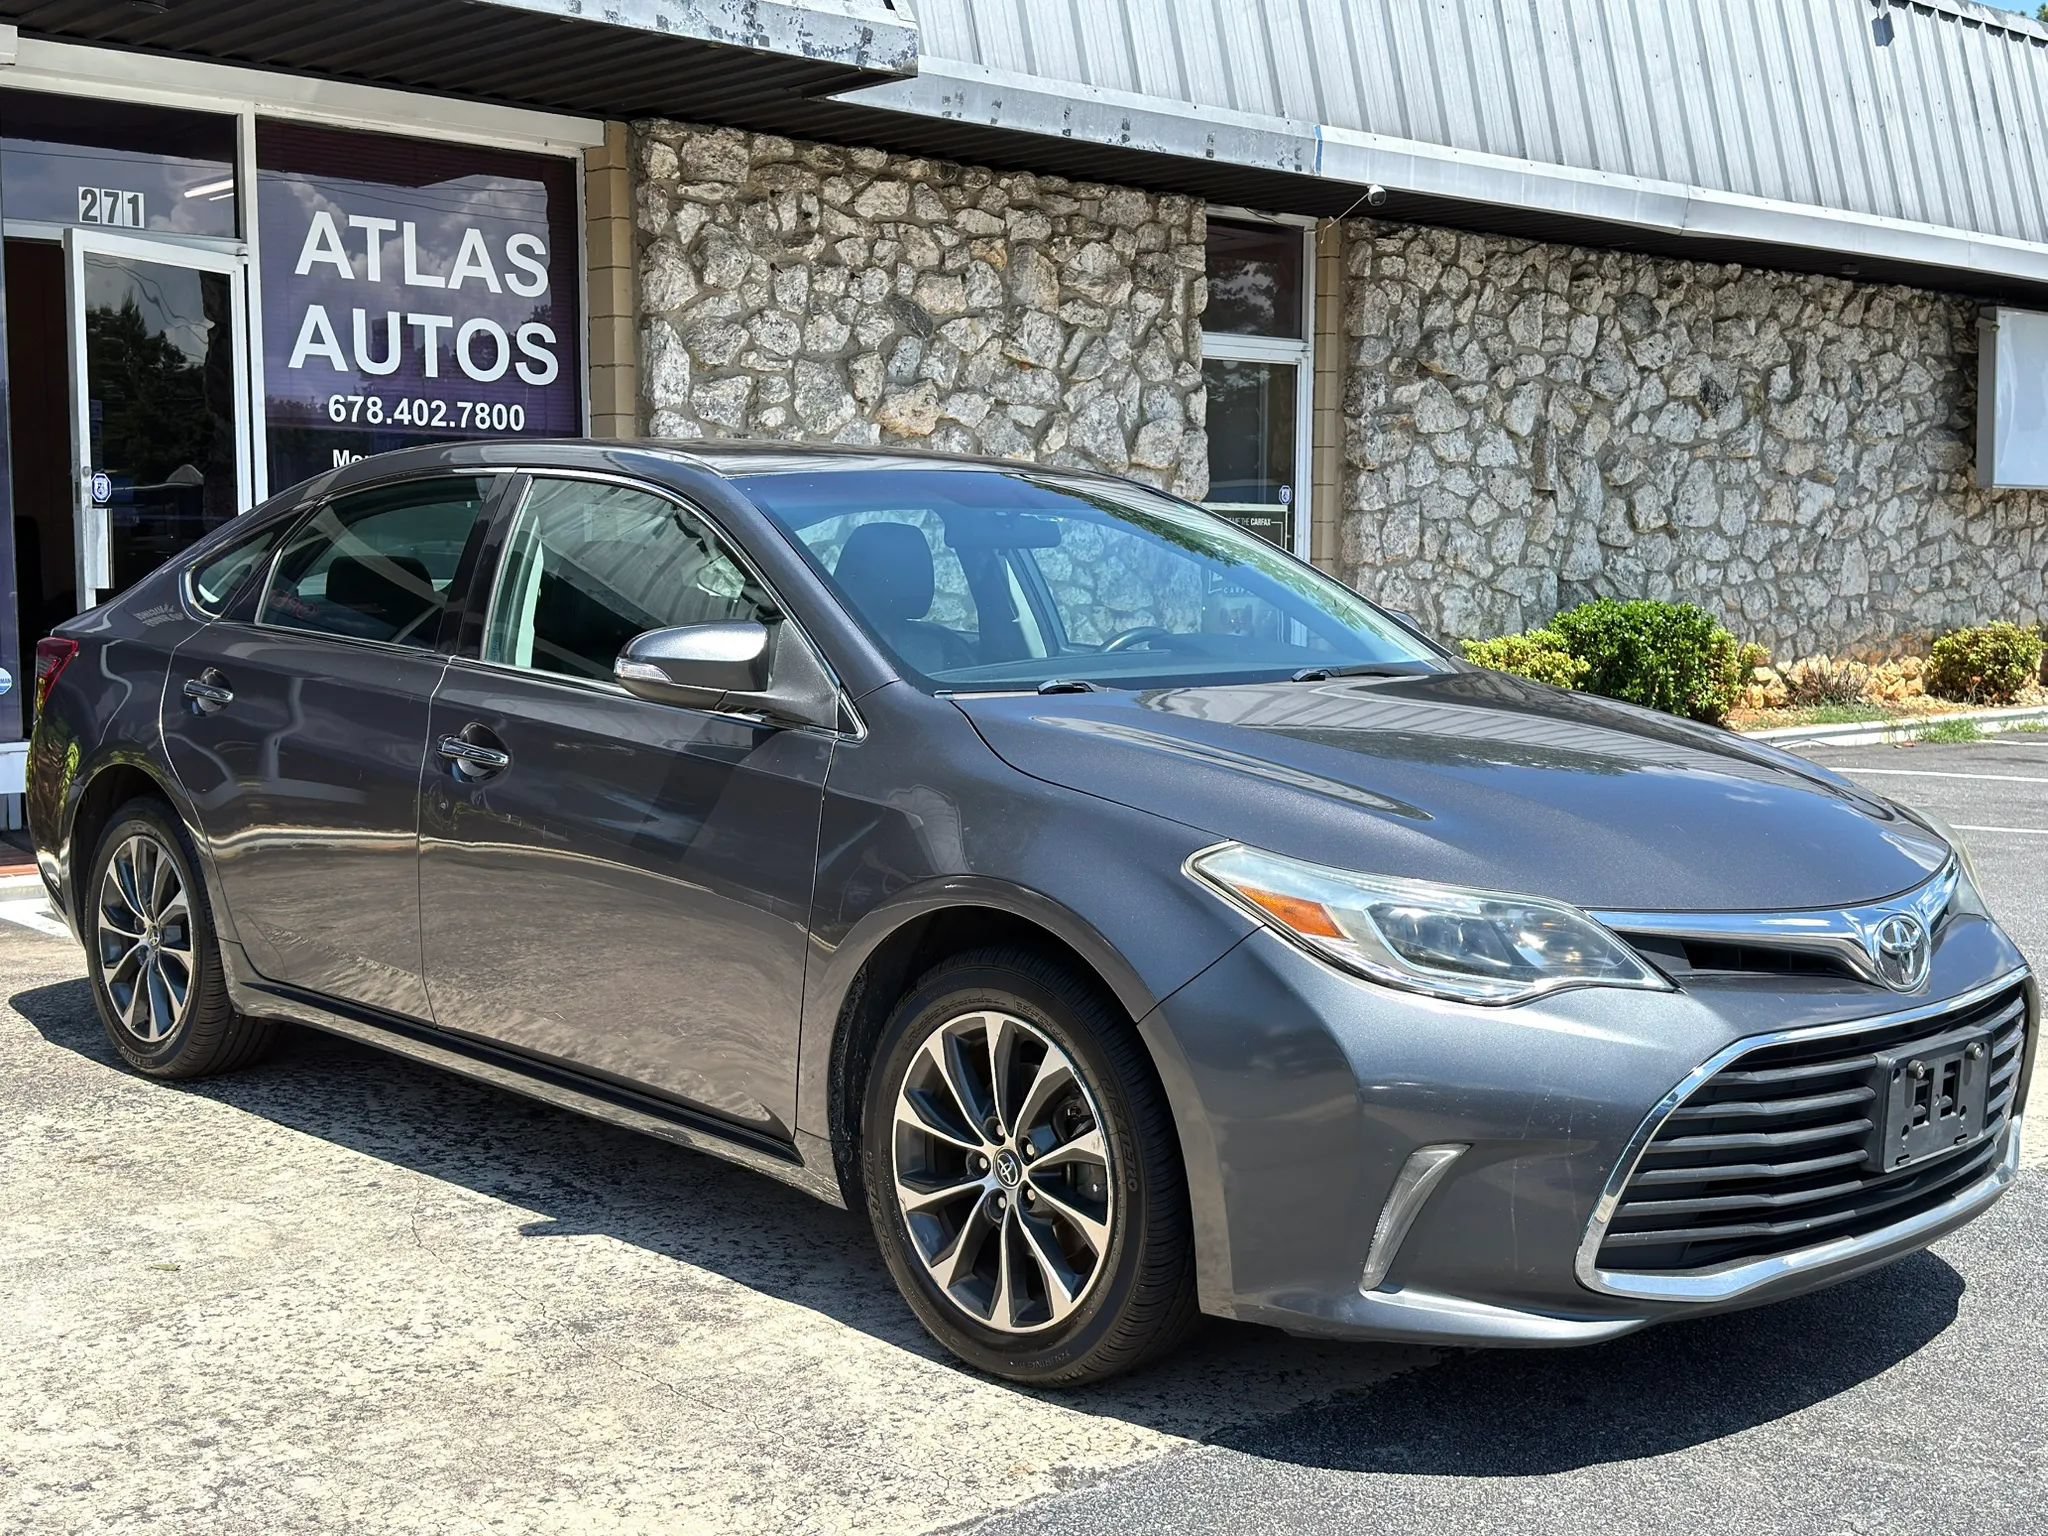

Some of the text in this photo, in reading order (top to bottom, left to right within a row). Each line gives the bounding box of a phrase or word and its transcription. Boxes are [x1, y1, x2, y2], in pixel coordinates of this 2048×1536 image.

[81, 188, 140, 226] 271
[295, 211, 549, 297] ATLAS
[288, 304, 559, 386] AUTOS
[328, 394, 525, 431] 678.402.7800
[1250, 517, 1272, 527] CARFAX
